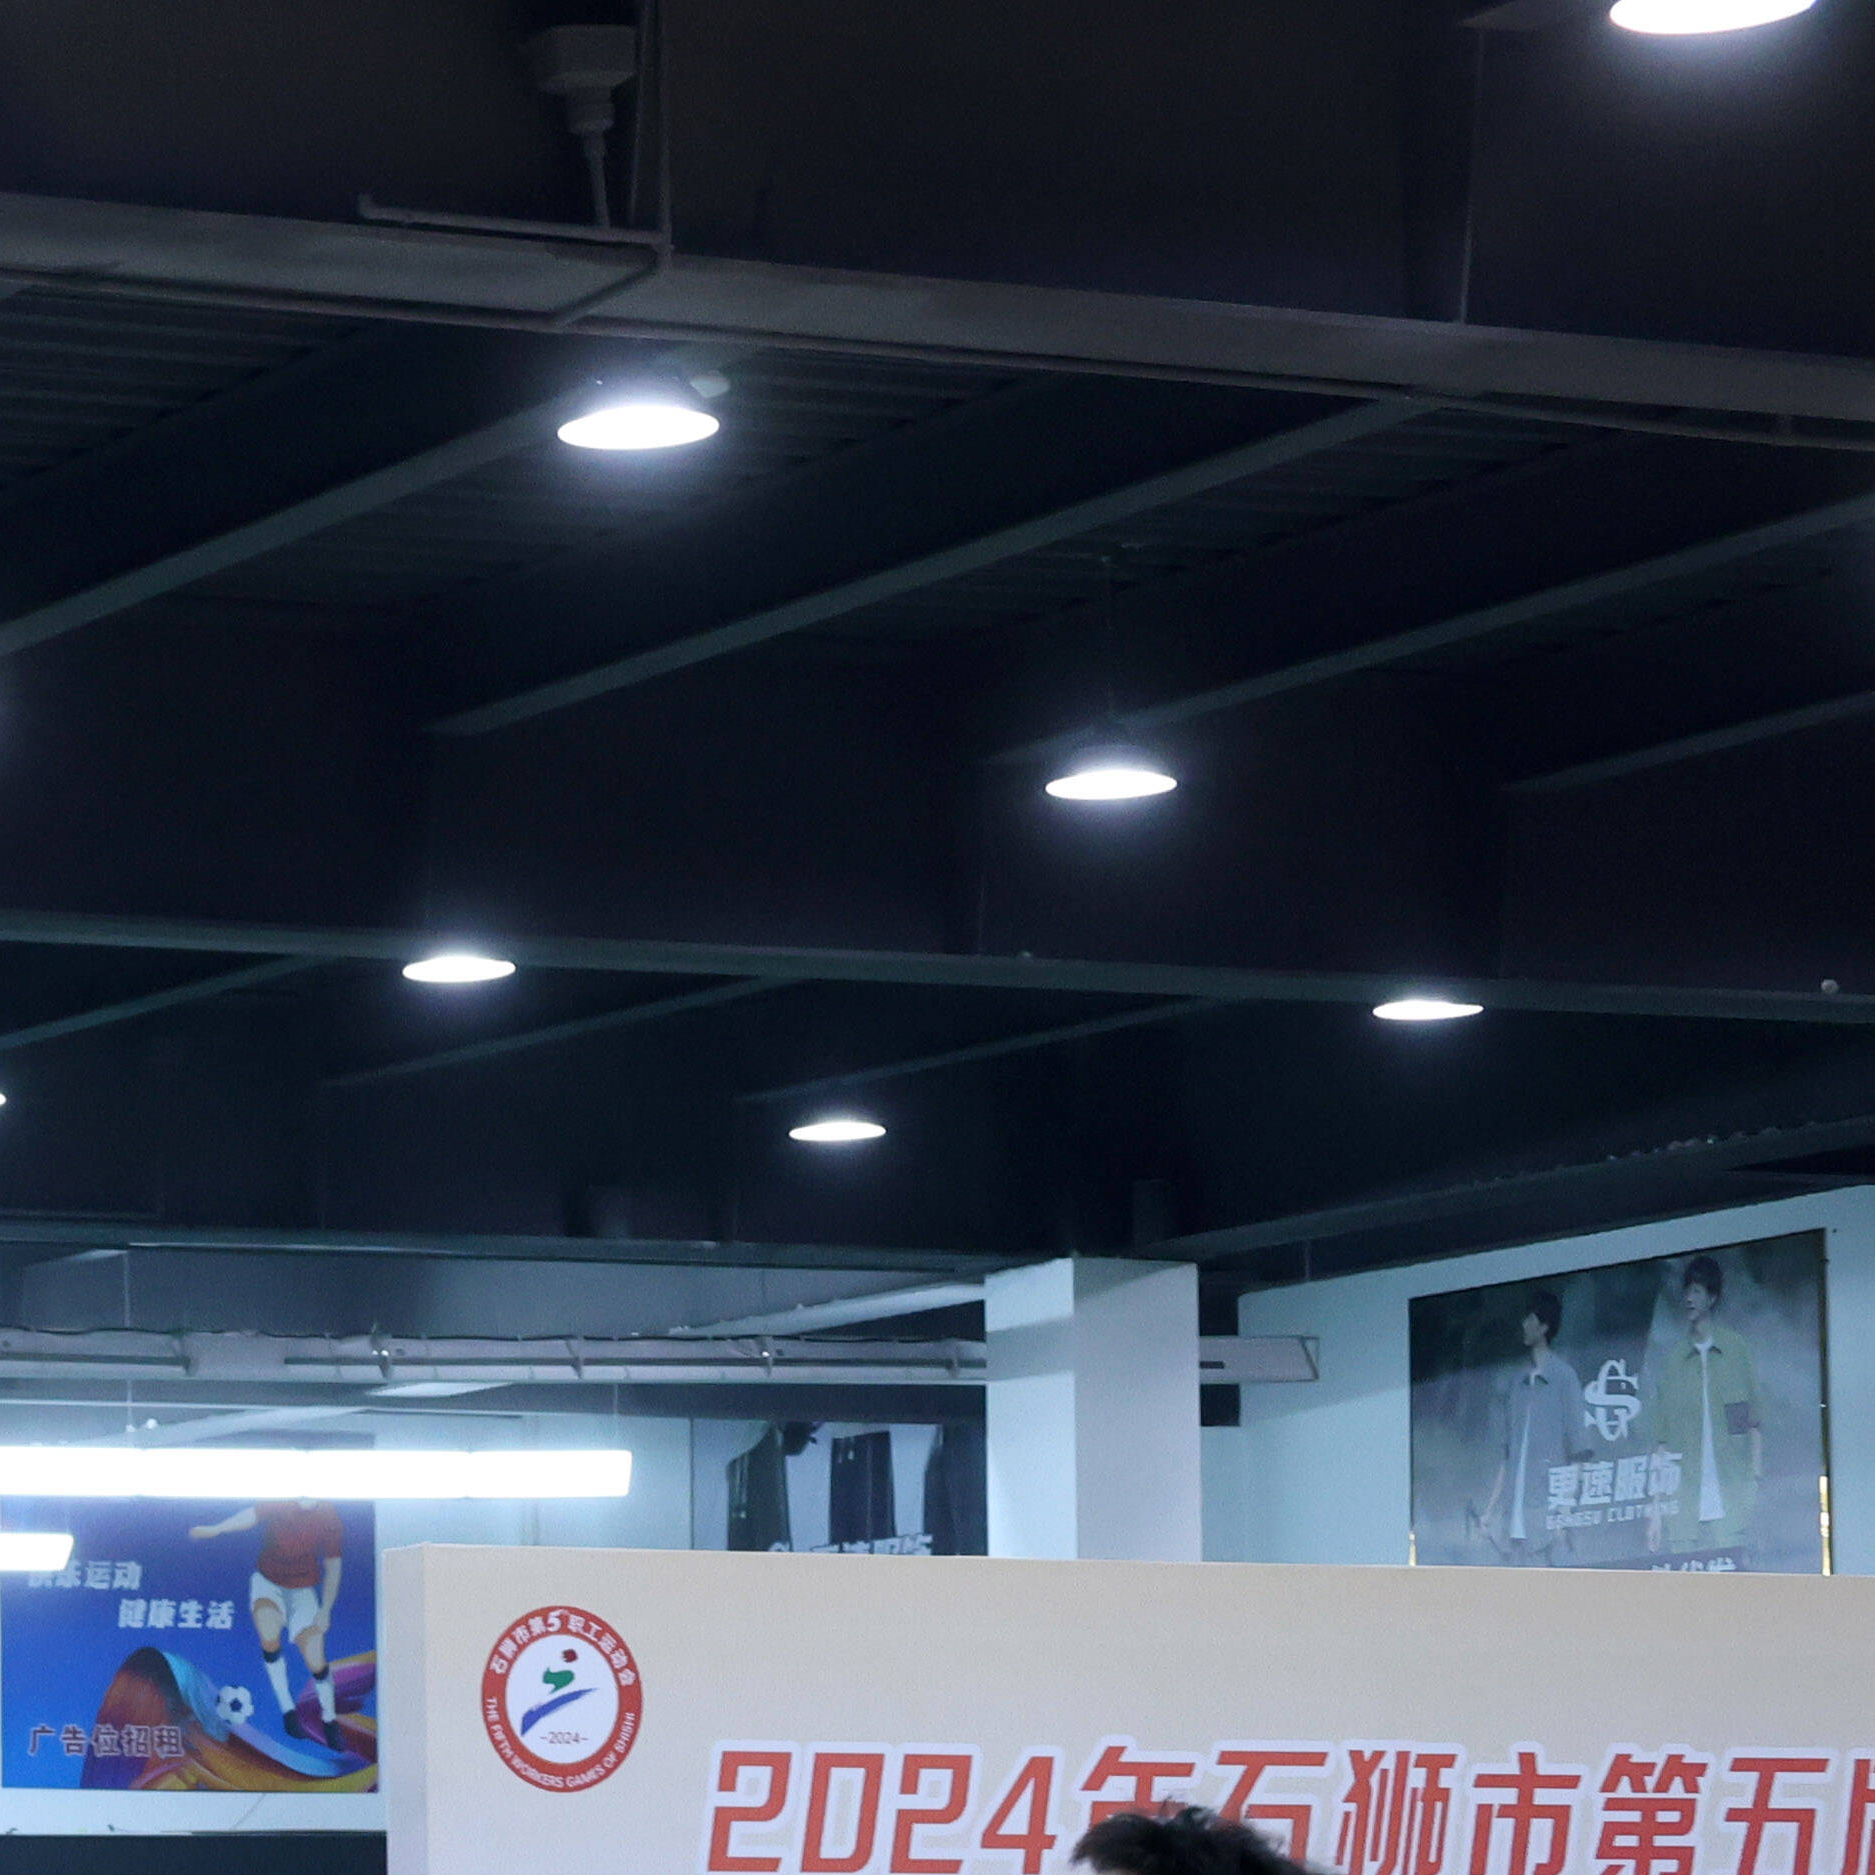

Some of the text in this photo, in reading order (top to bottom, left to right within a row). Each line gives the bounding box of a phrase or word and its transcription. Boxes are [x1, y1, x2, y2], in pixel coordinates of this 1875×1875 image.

[118, 1598, 235, 1630] 健康生活
[27, 1724, 186, 1760] 广告位招租
